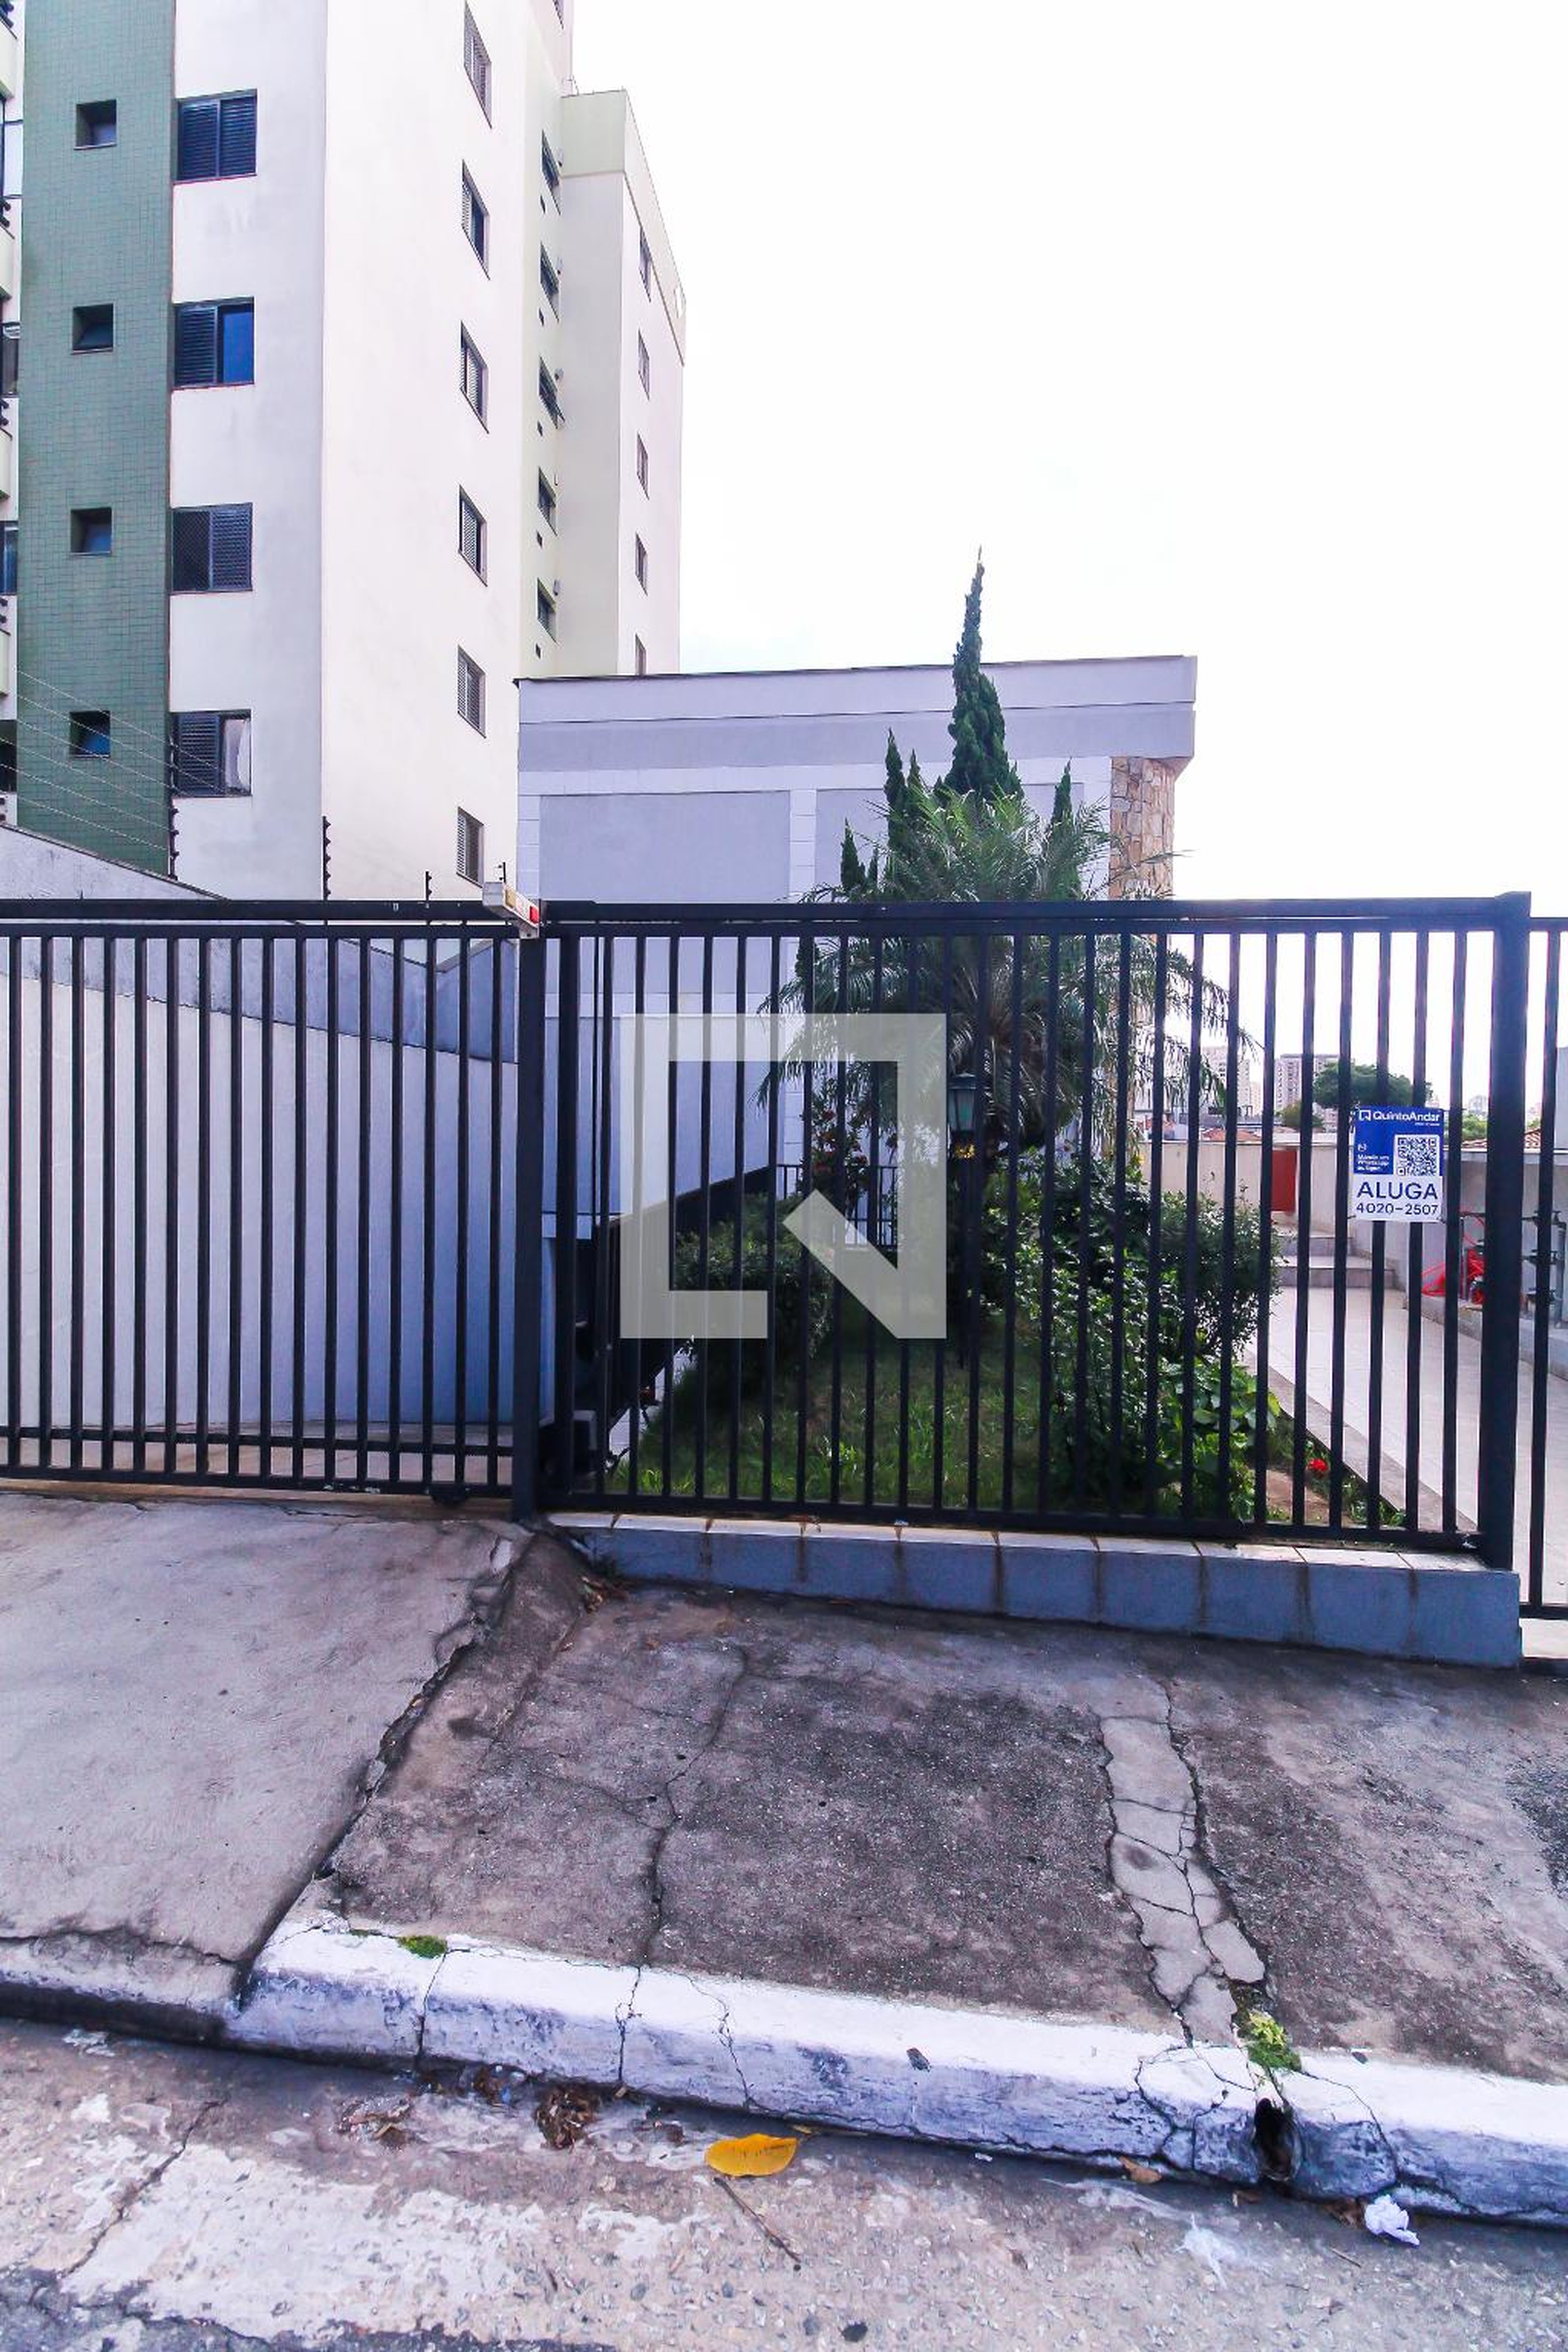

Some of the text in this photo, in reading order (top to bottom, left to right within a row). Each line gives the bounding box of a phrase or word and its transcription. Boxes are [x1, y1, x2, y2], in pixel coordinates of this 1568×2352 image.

[1373, 1111, 1439, 1121] QuintoAndar
[1357, 1182, 1437, 1199] ALUGA
[1356, 1203, 1438, 1215] 4020-2507
